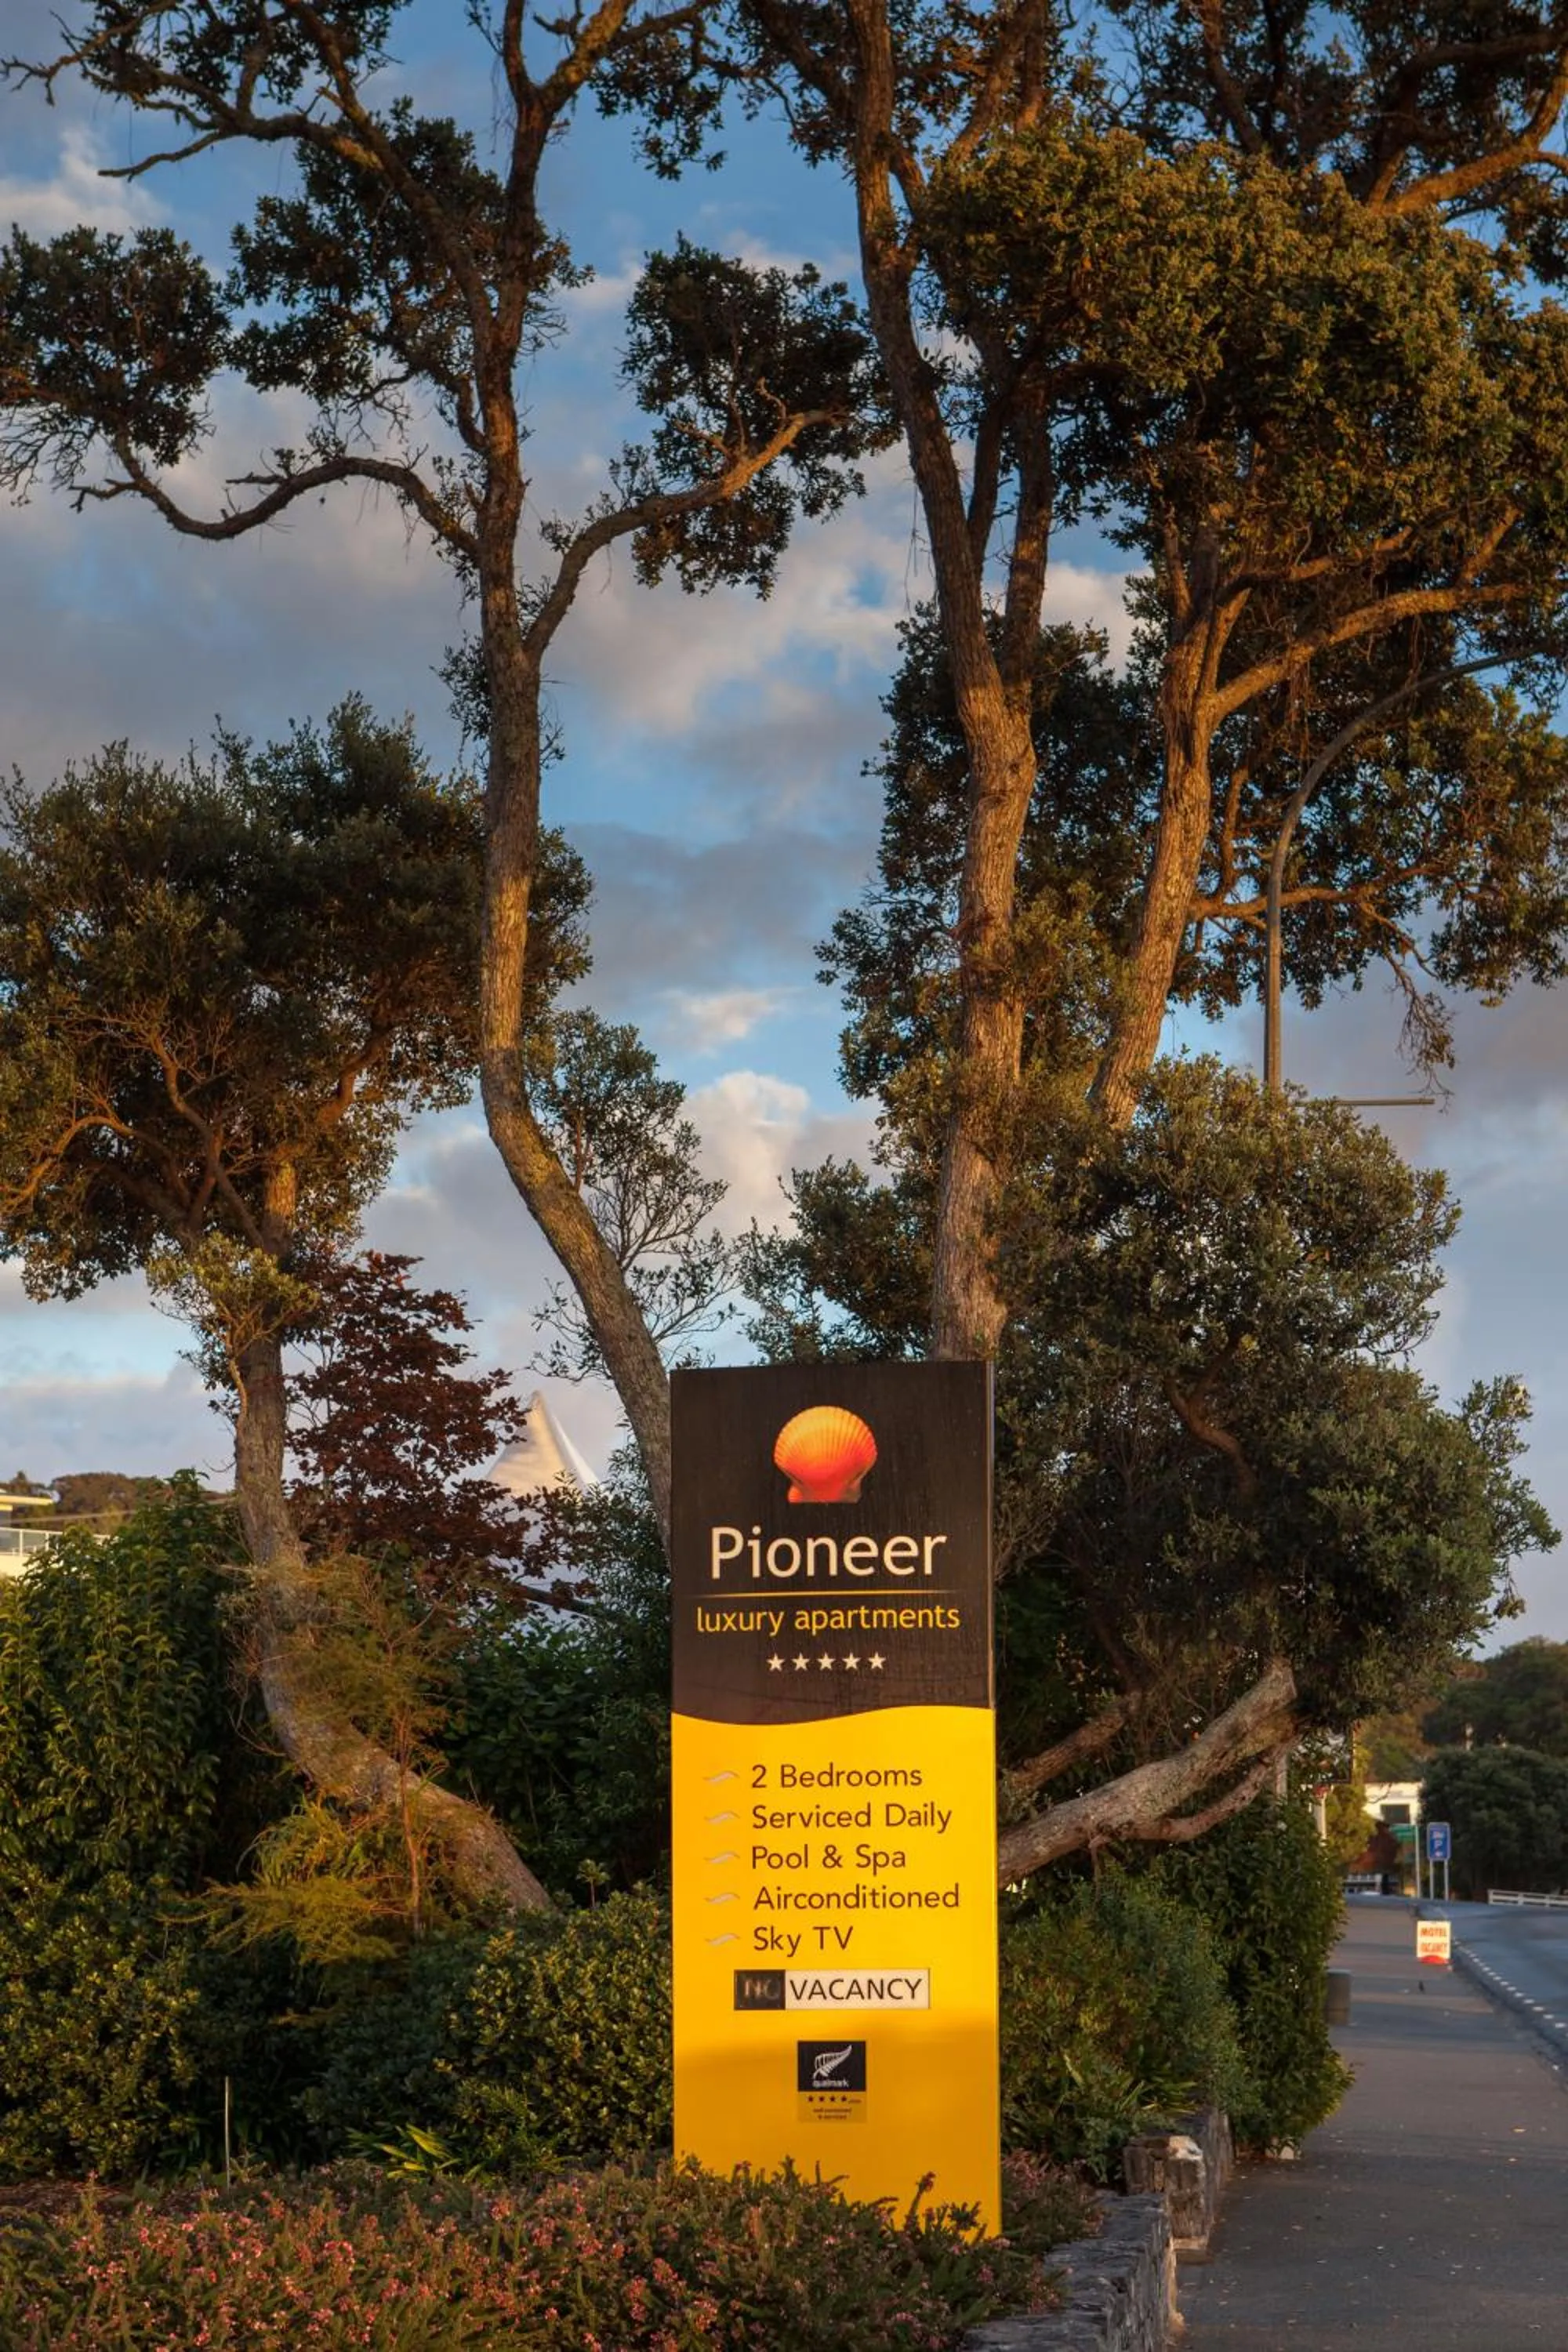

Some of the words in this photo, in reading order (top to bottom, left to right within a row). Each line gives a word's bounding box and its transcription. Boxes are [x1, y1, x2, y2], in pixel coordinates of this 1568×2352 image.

[713, 1526, 947, 1579] Pioneer
[697, 1606, 785, 1636] luxury
[794, 1605, 960, 1636] apartments
[752, 1764, 767, 1788] 2
[780, 1762, 923, 1788] Bedrooms
[753, 1802, 871, 1829] Serviced
[885, 1801, 953, 1835] Daily
[752, 1843, 808, 1870] Pool
[822, 1844, 843, 1869] &
[855, 1843, 906, 1877] Spa
[753, 1882, 960, 1911] Airconditioned
[753, 1925, 801, 1958] Sky
[813, 1926, 854, 1951] TV
[789, 1978, 922, 2000] VACANCY
